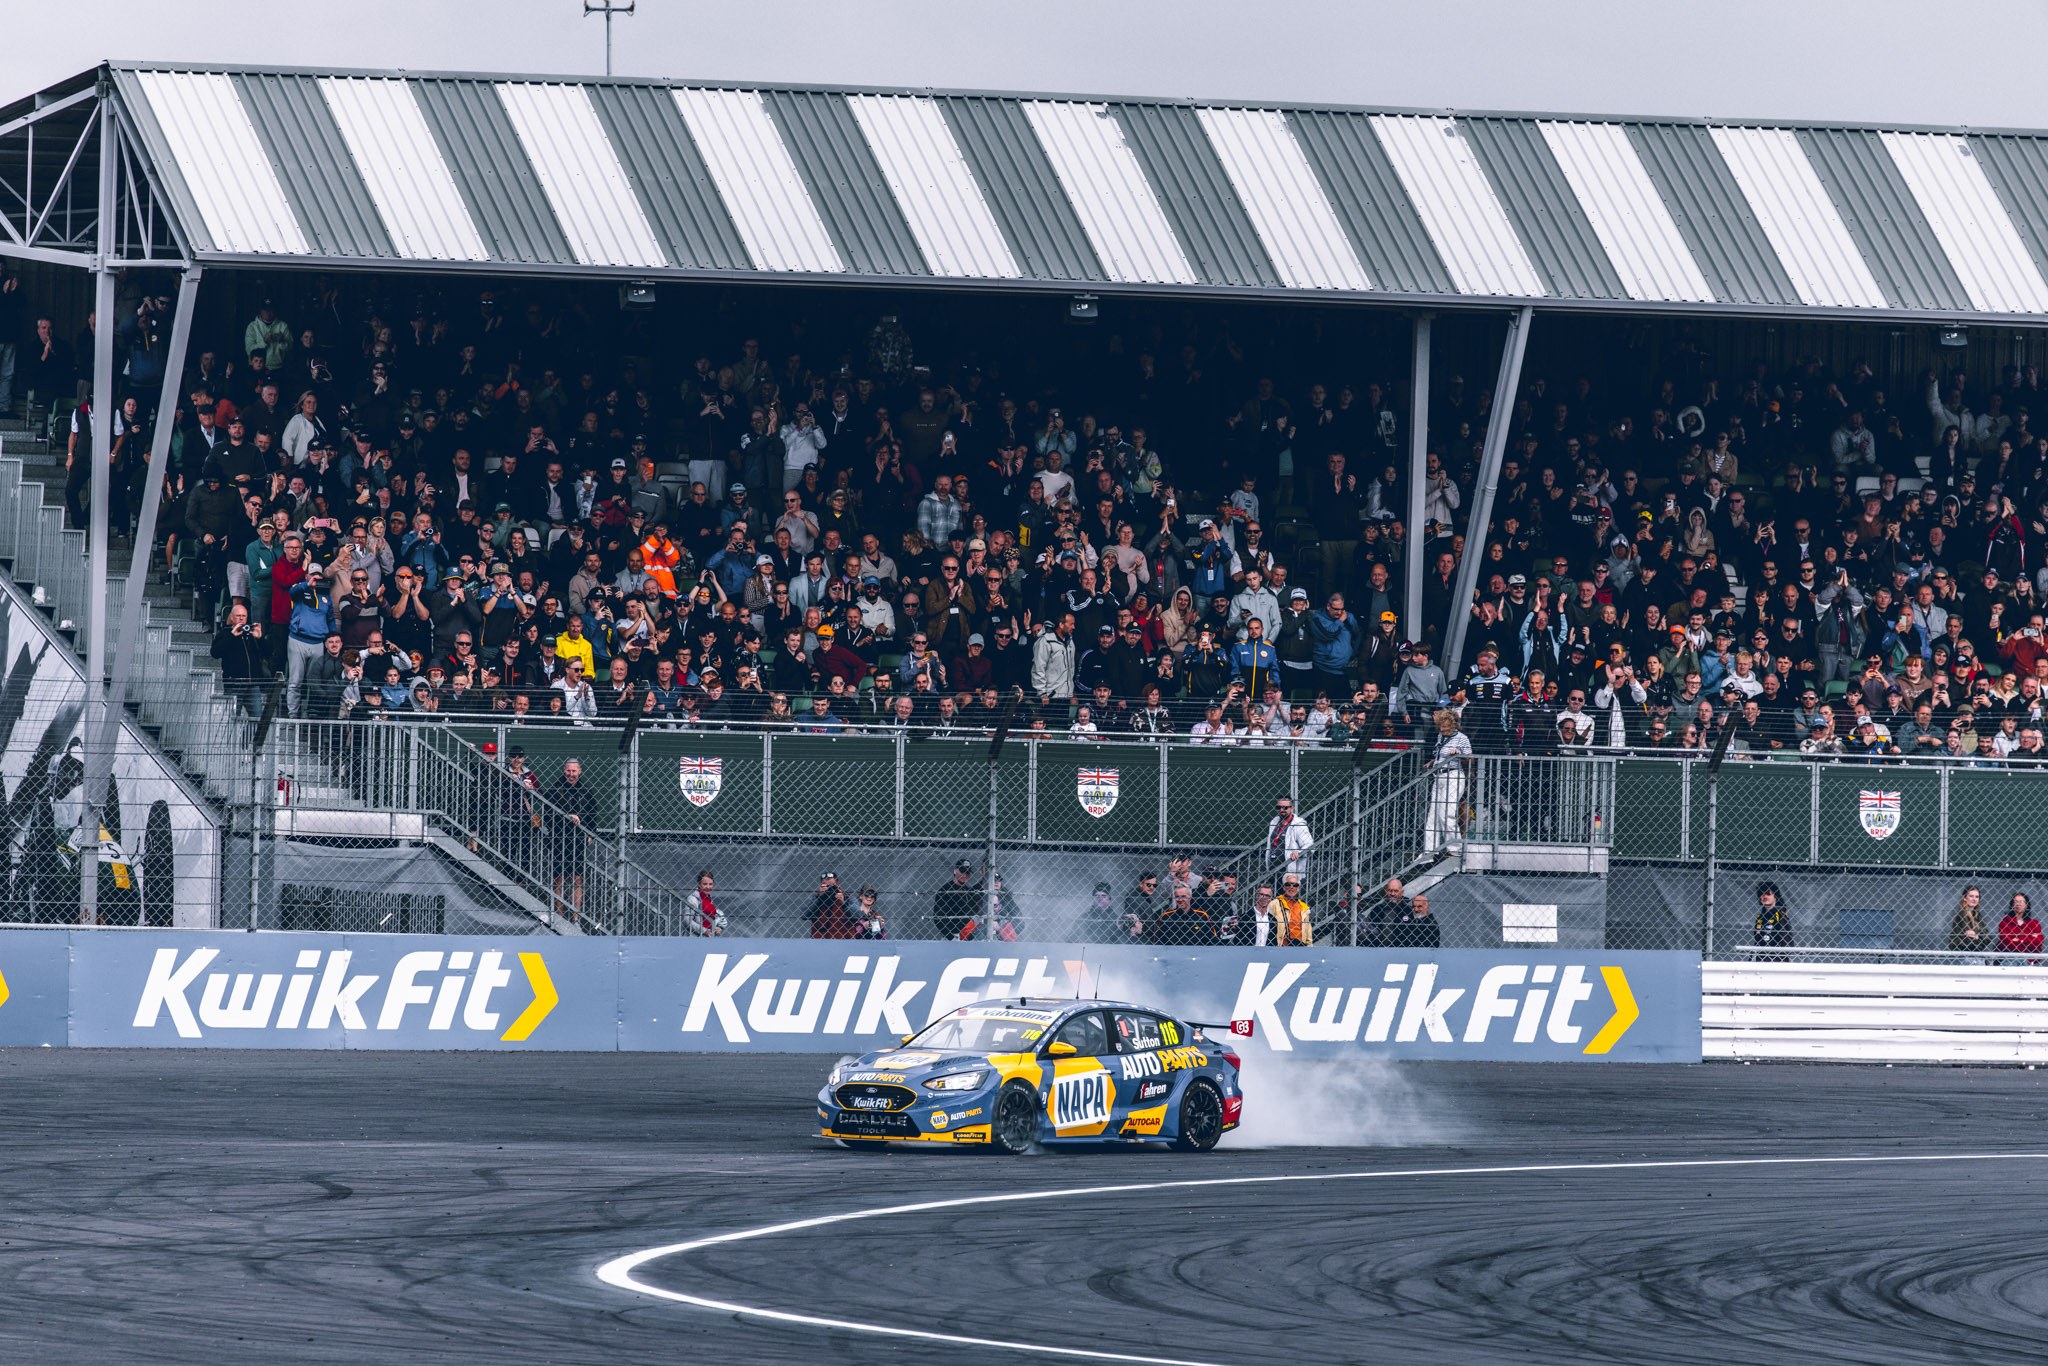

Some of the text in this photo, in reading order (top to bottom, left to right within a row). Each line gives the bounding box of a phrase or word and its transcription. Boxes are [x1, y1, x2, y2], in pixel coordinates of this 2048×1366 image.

[690, 794, 710, 804] BRDC
[1087, 805, 1107, 816] BRDC
[1870, 828, 1889, 837] BRDC
[1020, 1028, 1043, 1041] 116
[1159, 1021, 1179, 1046] 116
[1132, 1036, 1160, 1050] Sutton
[1120, 1045, 1208, 1081] AUTO PARTS
[849, 1072, 906, 1083] AUTO PARTS
[1140, 1082, 1167, 1099] fahren
[1057, 1076, 1106, 1124] NAPA
[839, 1112, 907, 1127] CARLYLE
[932, 1107, 982, 1125] NAPA AUTO PARTS
[1128, 1117, 1161, 1126] AUTOCAR
